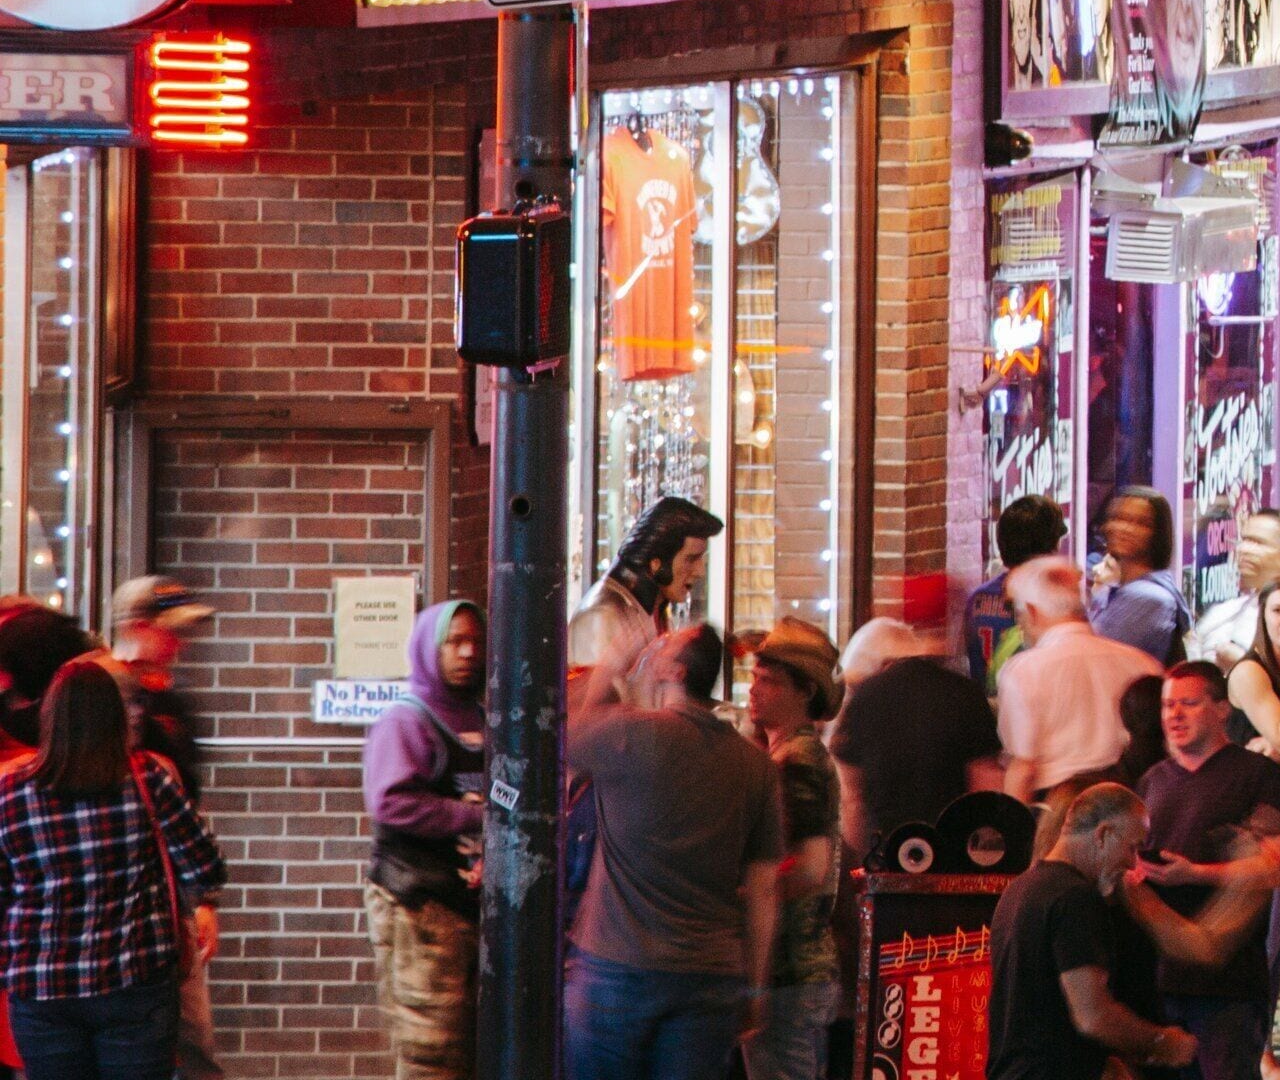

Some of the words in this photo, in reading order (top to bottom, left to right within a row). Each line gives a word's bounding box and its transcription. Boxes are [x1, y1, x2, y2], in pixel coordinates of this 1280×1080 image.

[0, 70, 115, 113] ER
[355, 601, 381, 609] PLEASE
[383, 601, 396, 609] USE
[353, 614, 377, 622] OTHER
[379, 614, 398, 622] DOOR
[325, 684, 348, 701] No
[321, 699, 386, 717] Restro
